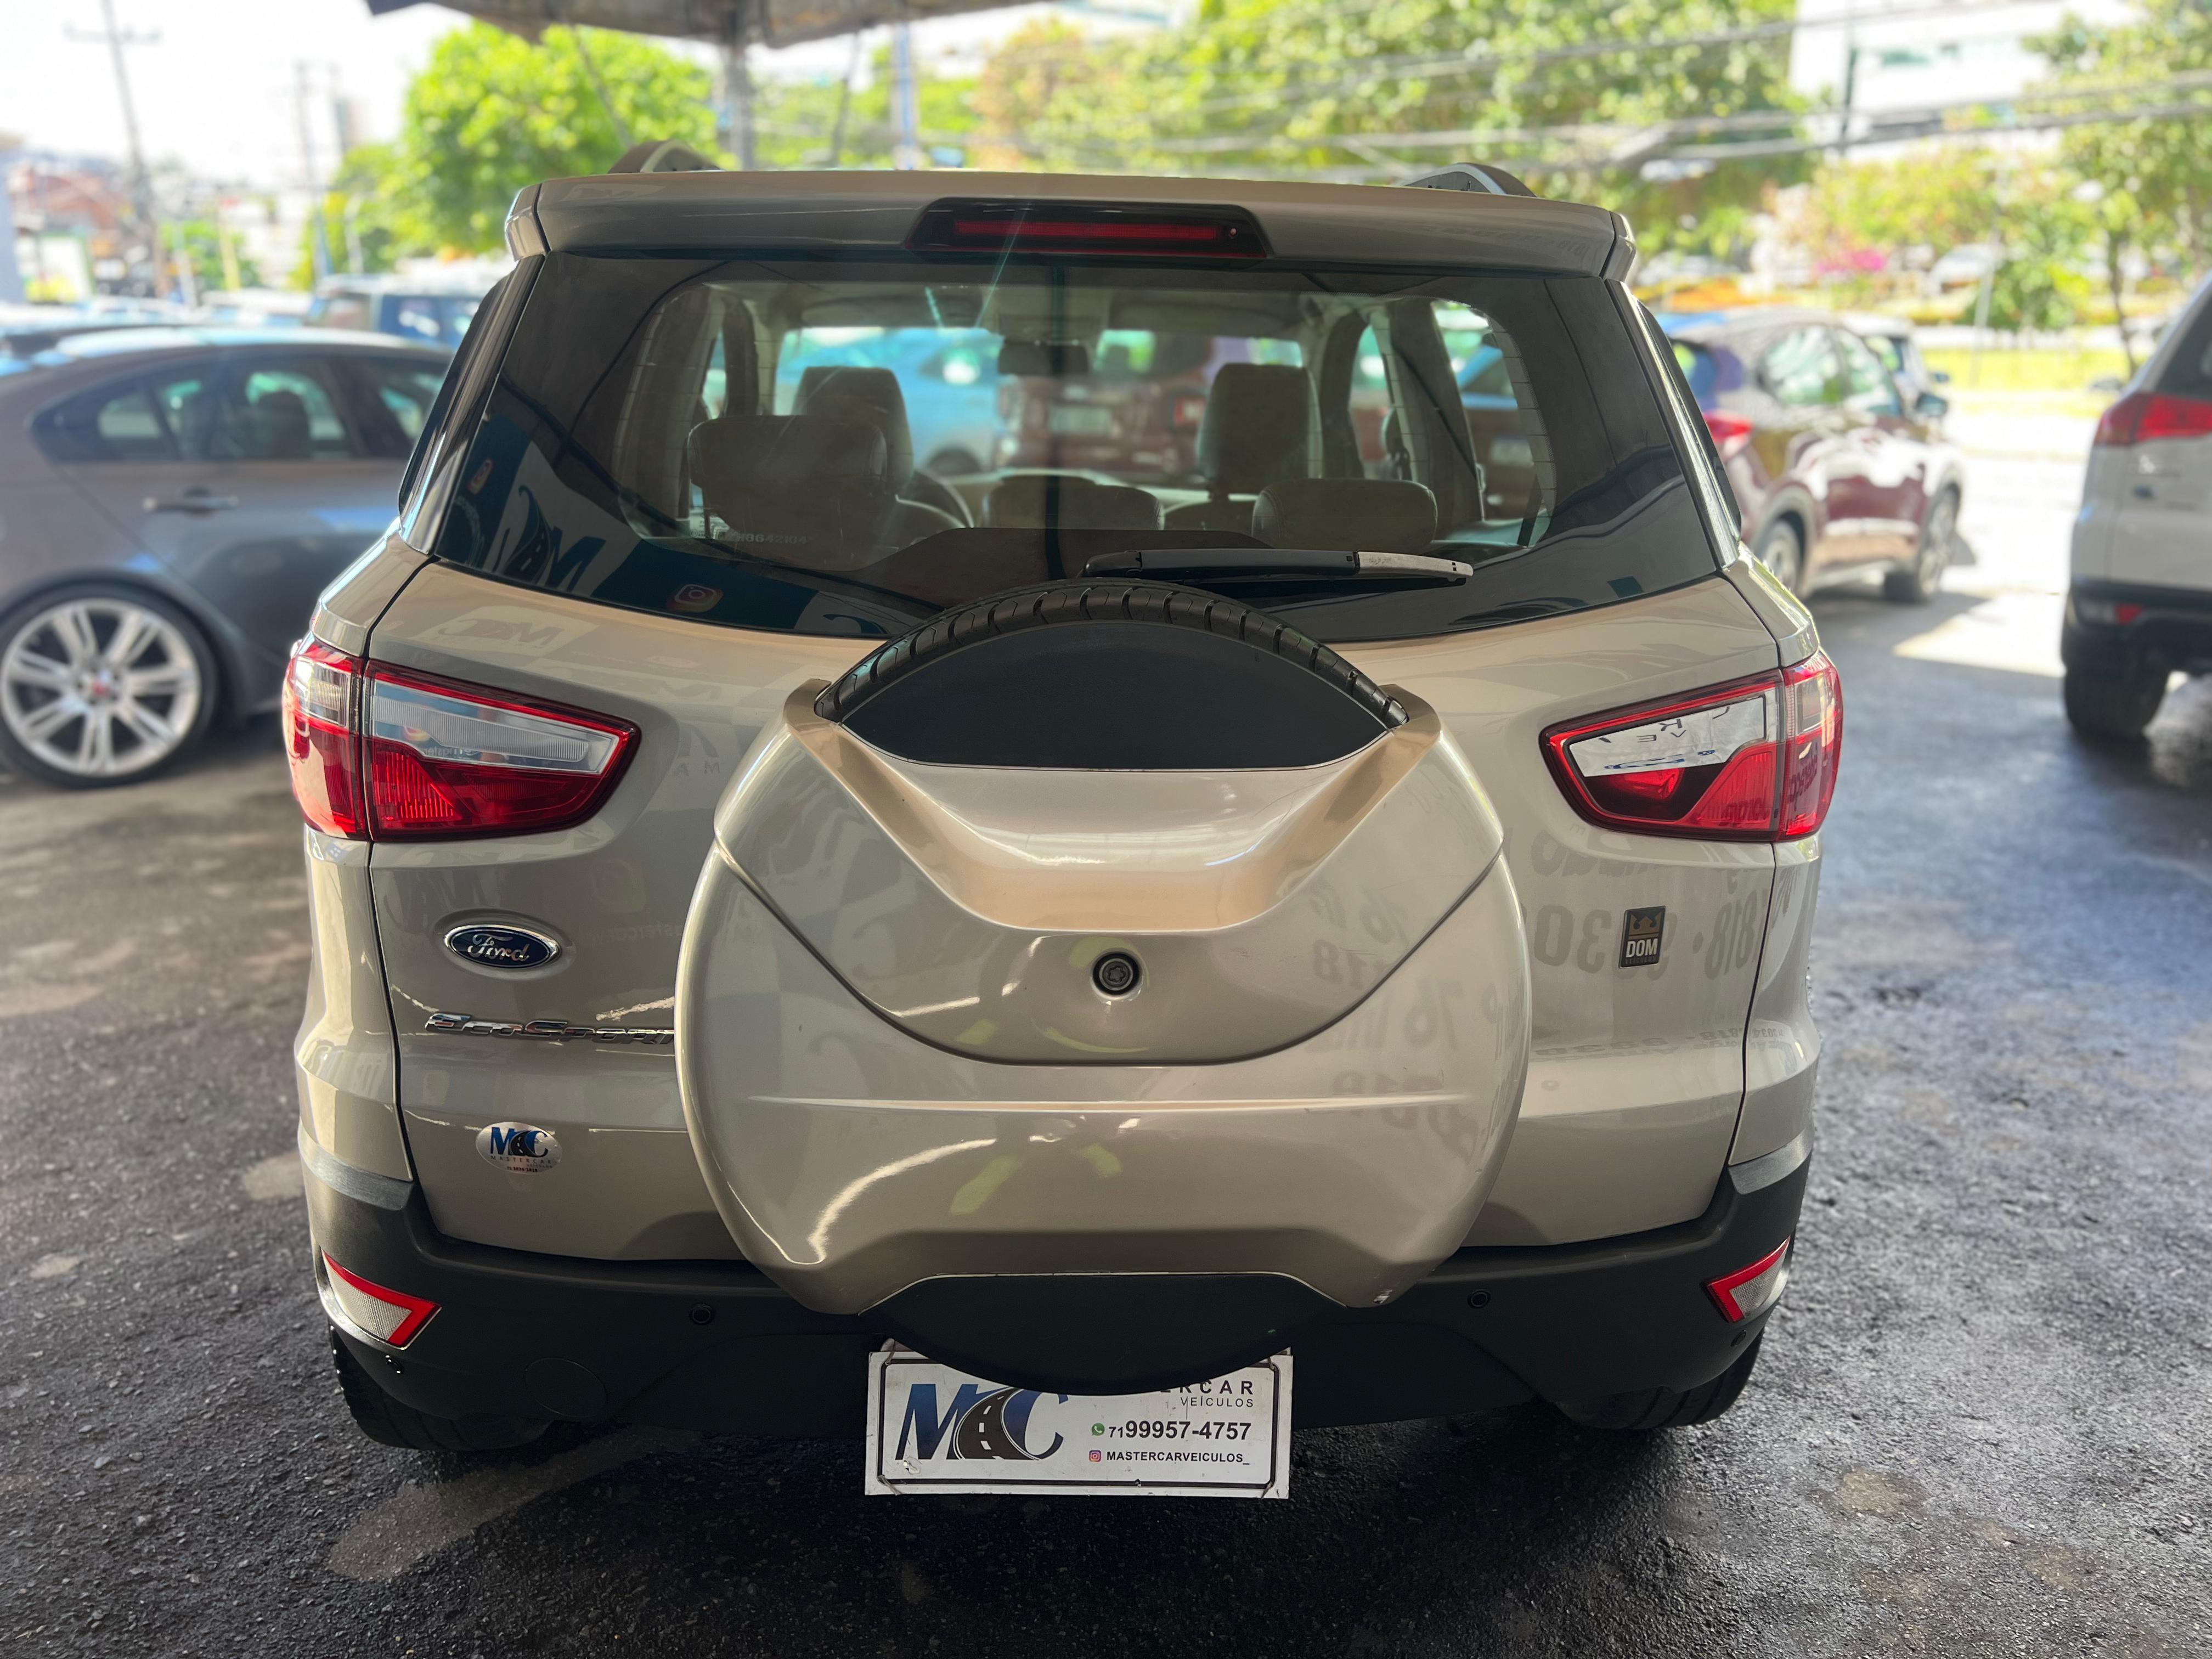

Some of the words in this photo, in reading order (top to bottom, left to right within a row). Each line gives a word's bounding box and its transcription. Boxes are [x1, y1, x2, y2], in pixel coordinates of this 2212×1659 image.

[467, 933, 529, 961] Ford
[1626, 938, 1658, 958] DOM
[1180, 1395, 1254, 1408] VEÍCULOS
